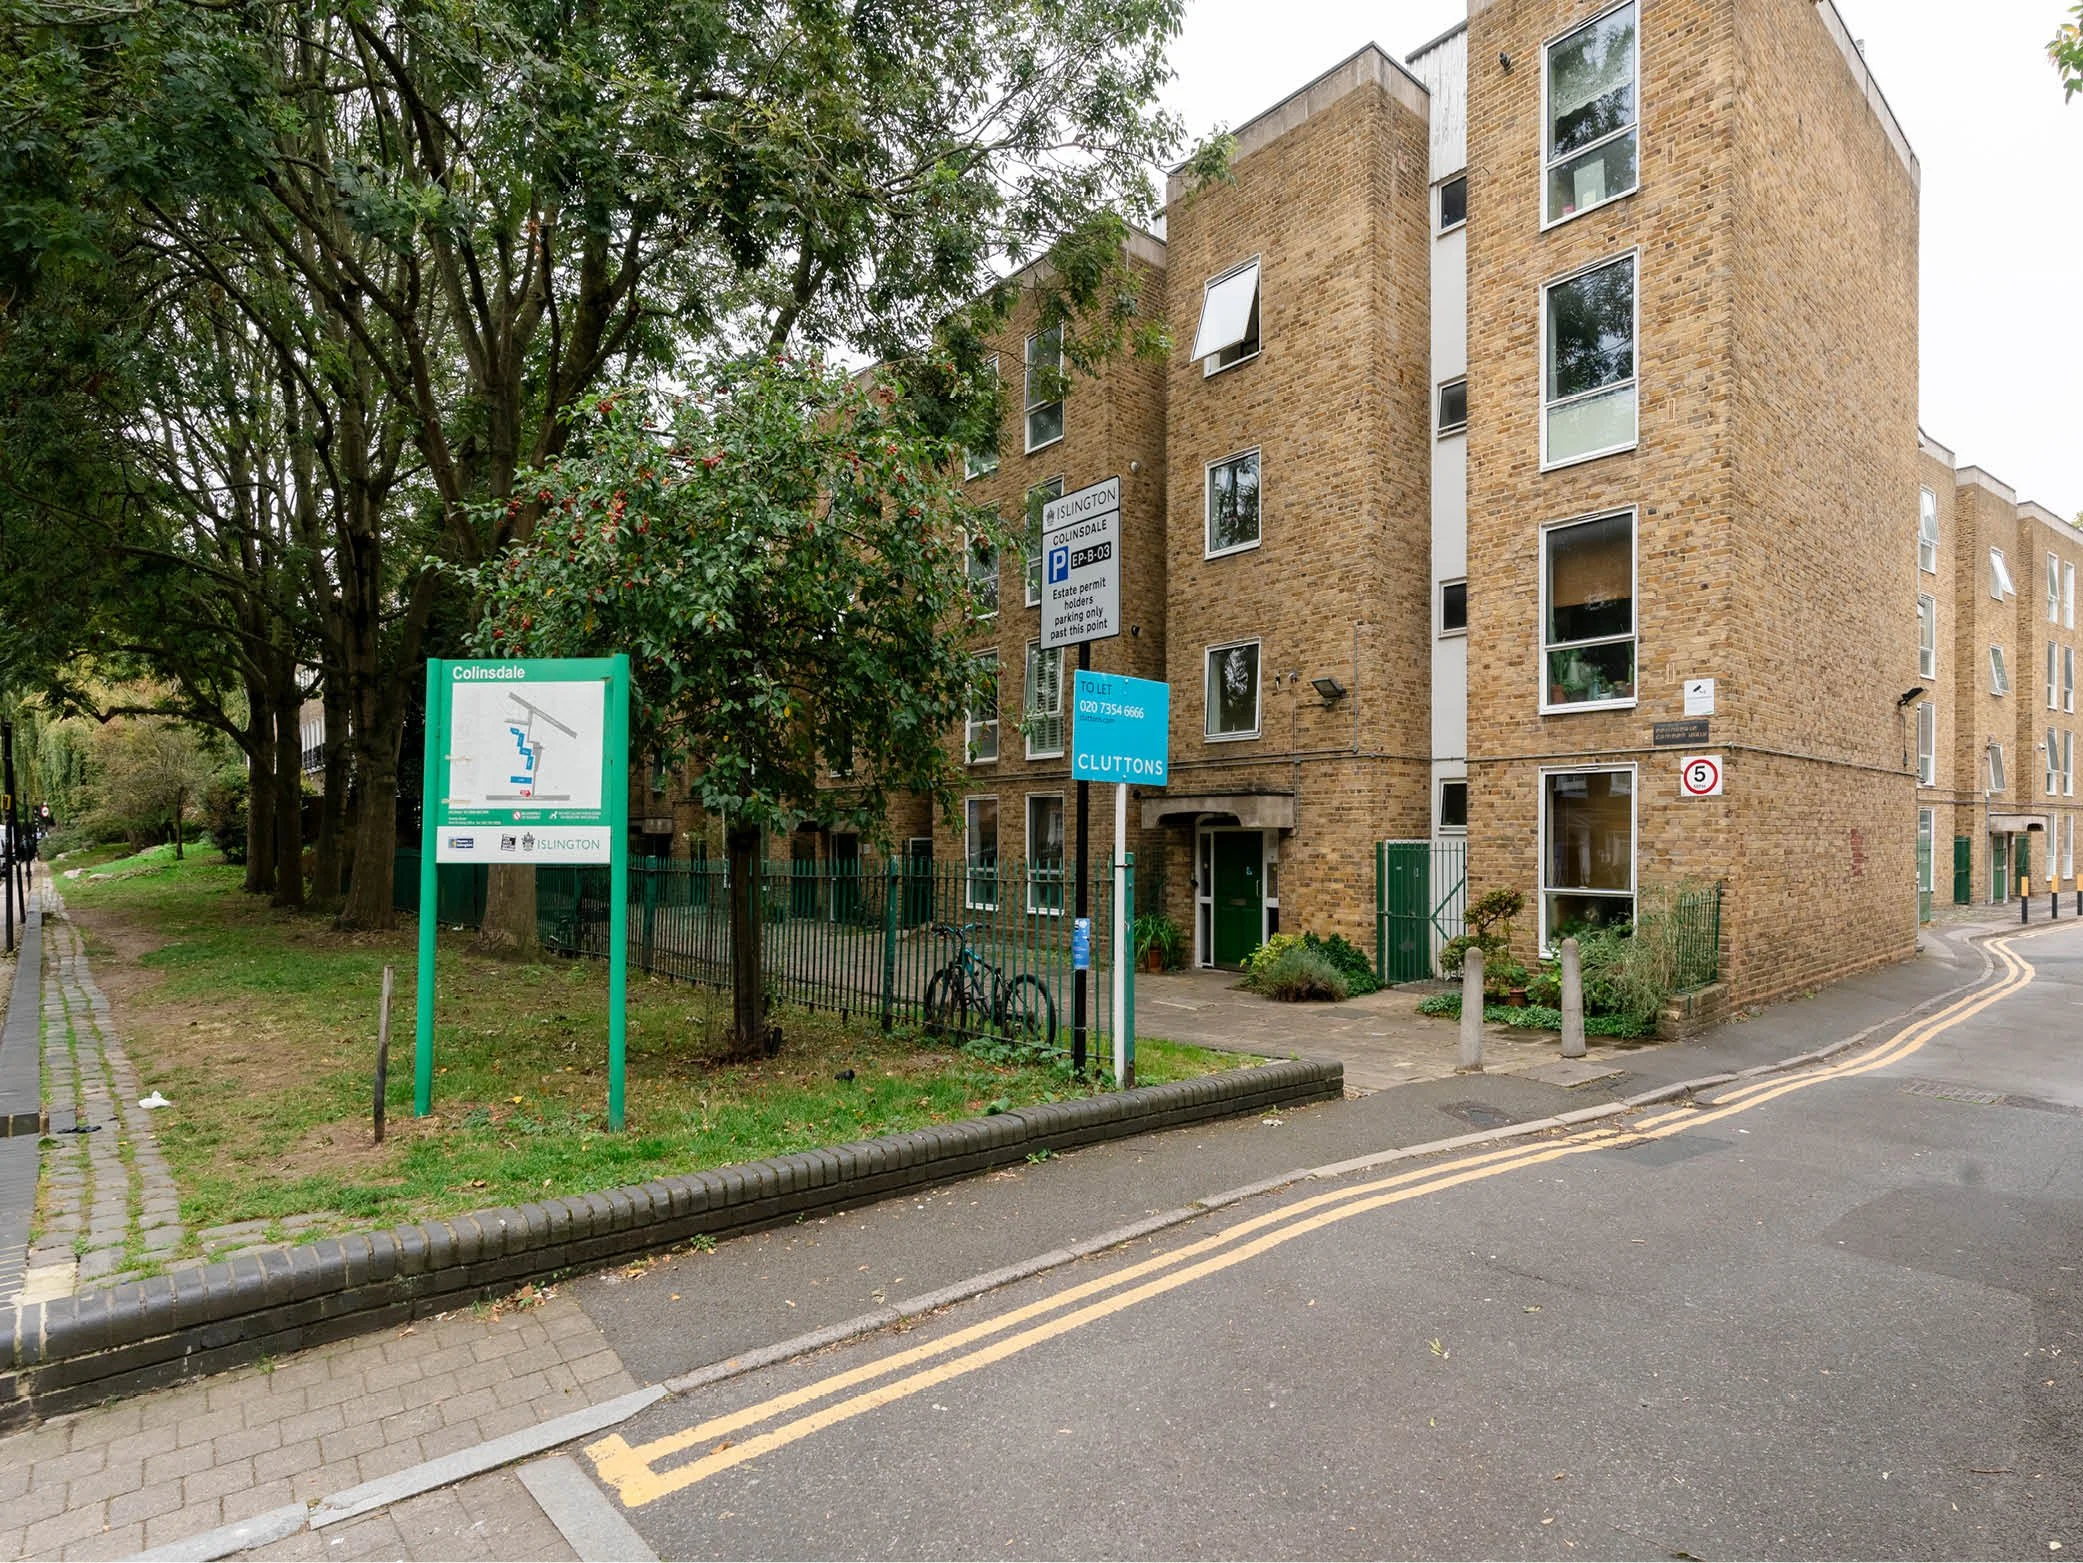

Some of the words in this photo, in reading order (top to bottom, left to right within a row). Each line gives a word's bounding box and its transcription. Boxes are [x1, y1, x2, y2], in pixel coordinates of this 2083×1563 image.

[1057, 487, 1116, 520] ISLINGTON
[1052, 519, 1107, 546] COLINSDALE
[1053, 549, 1067, 581] P
[1053, 585, 1077, 600] Estate
[1080, 577, 1106, 596] permit
[1064, 596, 1094, 610] holders
[1055, 611, 1084, 629] parking
[1086, 605, 1104, 618] only
[1050, 627, 1067, 641] past
[1069, 623, 1084, 636] this
[1086, 617, 1108, 634] point
[452, 664, 526, 680] Colinsdale
[1081, 681, 1095, 694] TO
[1097, 683, 1113, 696] LET
[1080, 700, 1098, 713] 020
[1100, 702, 1122, 716] 7354
[1124, 705, 1145, 720] 6666
[1078, 753, 1164, 776] CLUTTONS
[1694, 765, 1706, 783] 5
[537, 839, 600, 850] ISLINGTON
